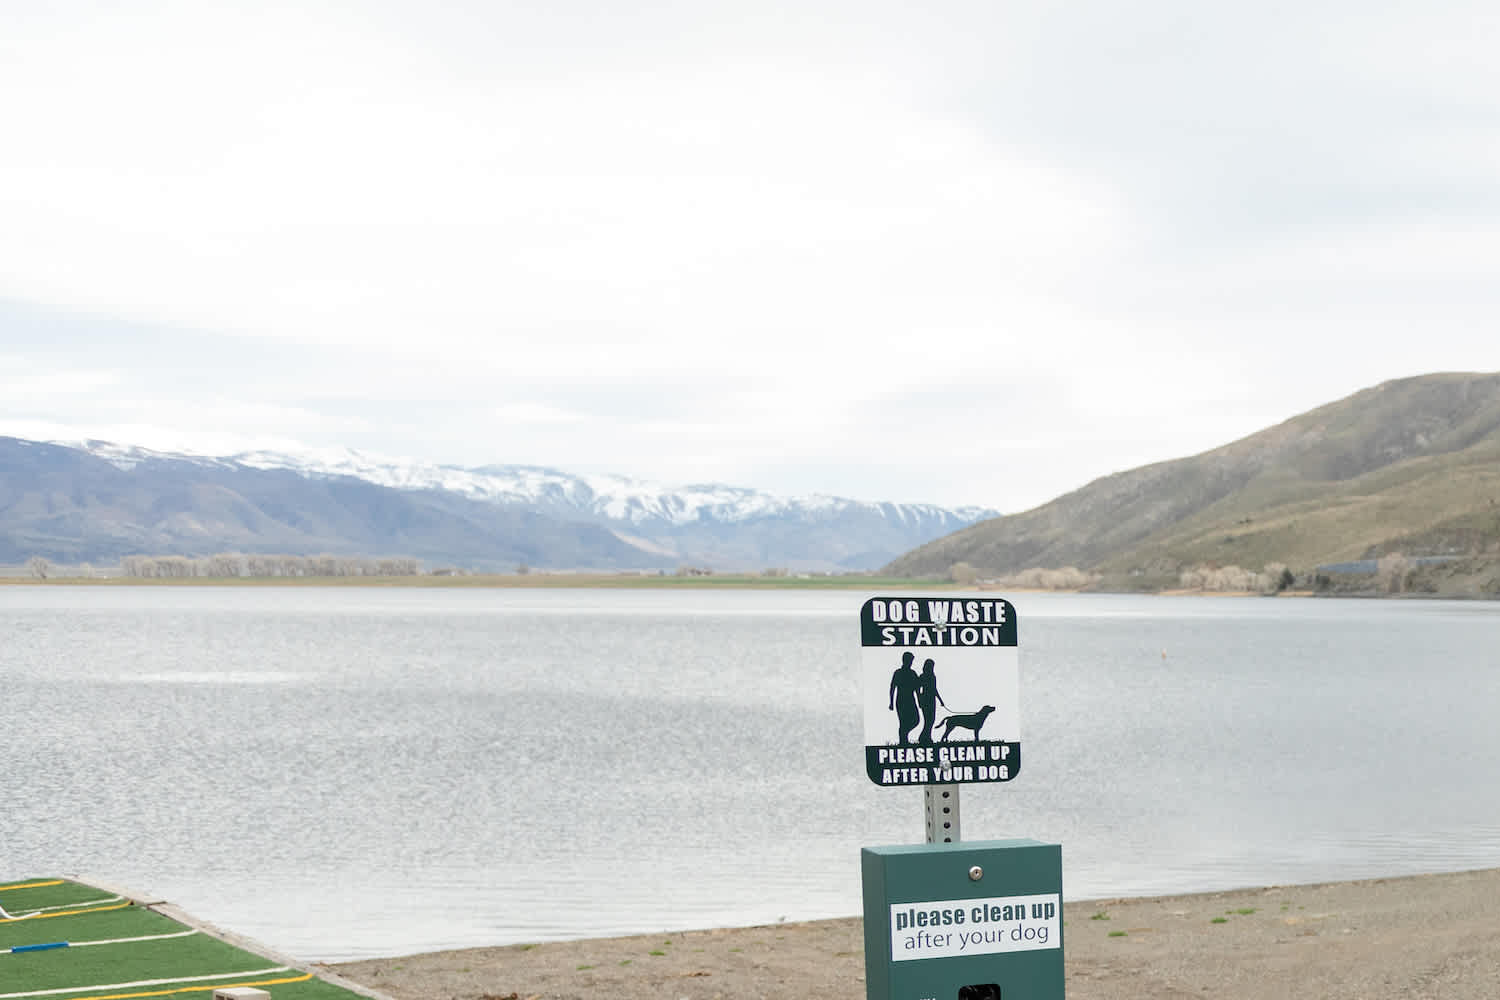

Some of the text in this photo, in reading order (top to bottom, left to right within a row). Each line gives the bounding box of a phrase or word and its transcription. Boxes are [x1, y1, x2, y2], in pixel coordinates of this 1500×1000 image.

[872, 600, 1007, 623] DOG WASTE
[881, 627, 999, 646] STATION
[878, 745, 1011, 764] PLEASE CLEAN UP
[882, 765, 1009, 784] AFTER YOUR DOG
[896, 902, 1055, 931] please clean up
[904, 923, 1049, 950] after your dog
